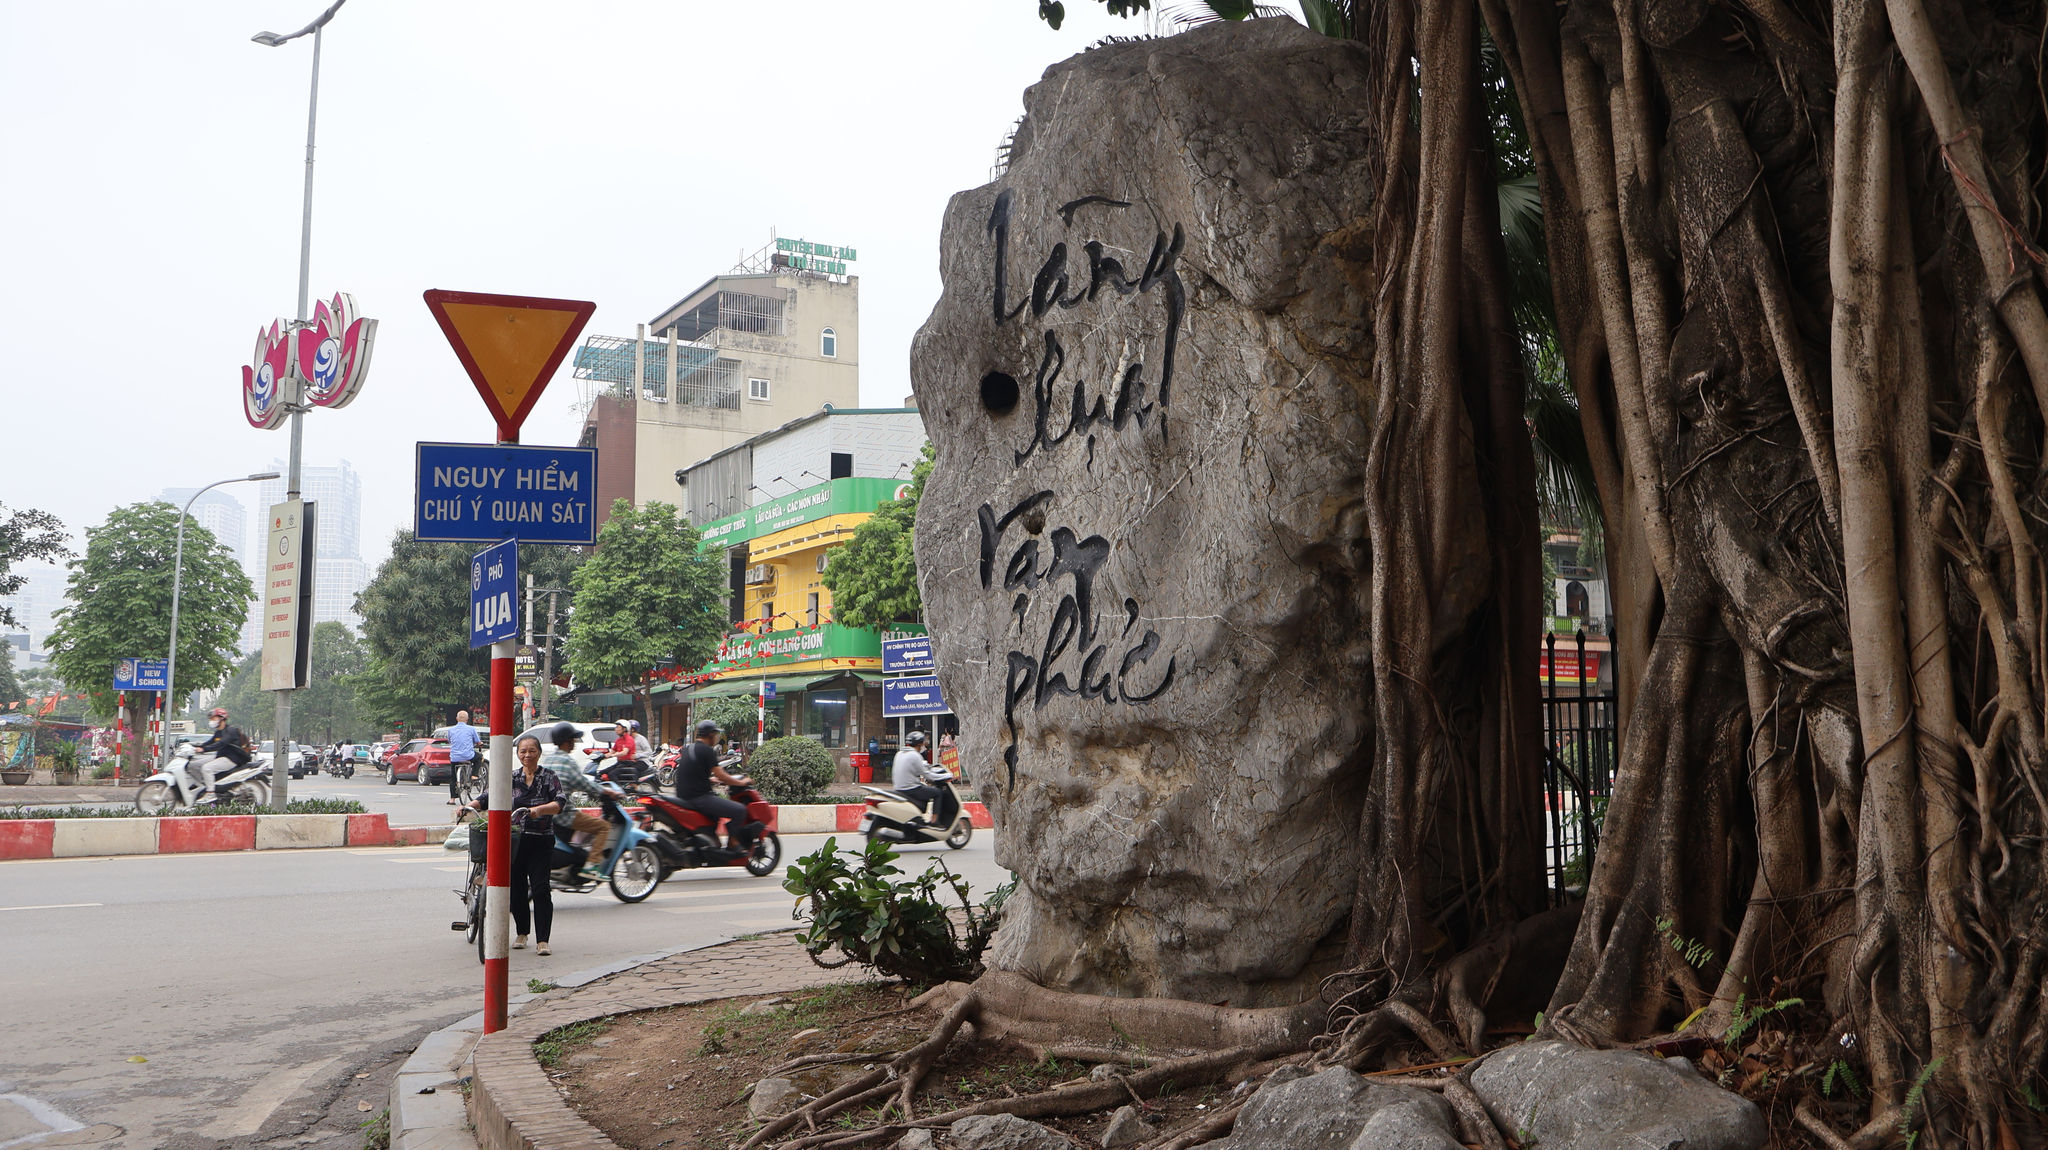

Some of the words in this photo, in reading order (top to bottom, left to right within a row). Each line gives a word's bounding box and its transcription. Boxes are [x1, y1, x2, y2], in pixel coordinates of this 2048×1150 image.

[434, 467, 505, 488] NGUY
[516, 459, 578, 491] HIỂM
[424, 494, 462, 521] CHÚ
[470, 495, 483, 521] Ý
[491, 500, 543, 522] QUAN
[551, 497, 586, 523] SÁT
[488, 554, 503, 582] PHỐ
[475, 591, 512, 635] LỤA
[144, 669, 161, 677] NEW
[515, 656, 535, 664] HOTEL
[138, 678, 166, 686] SCHOOL
